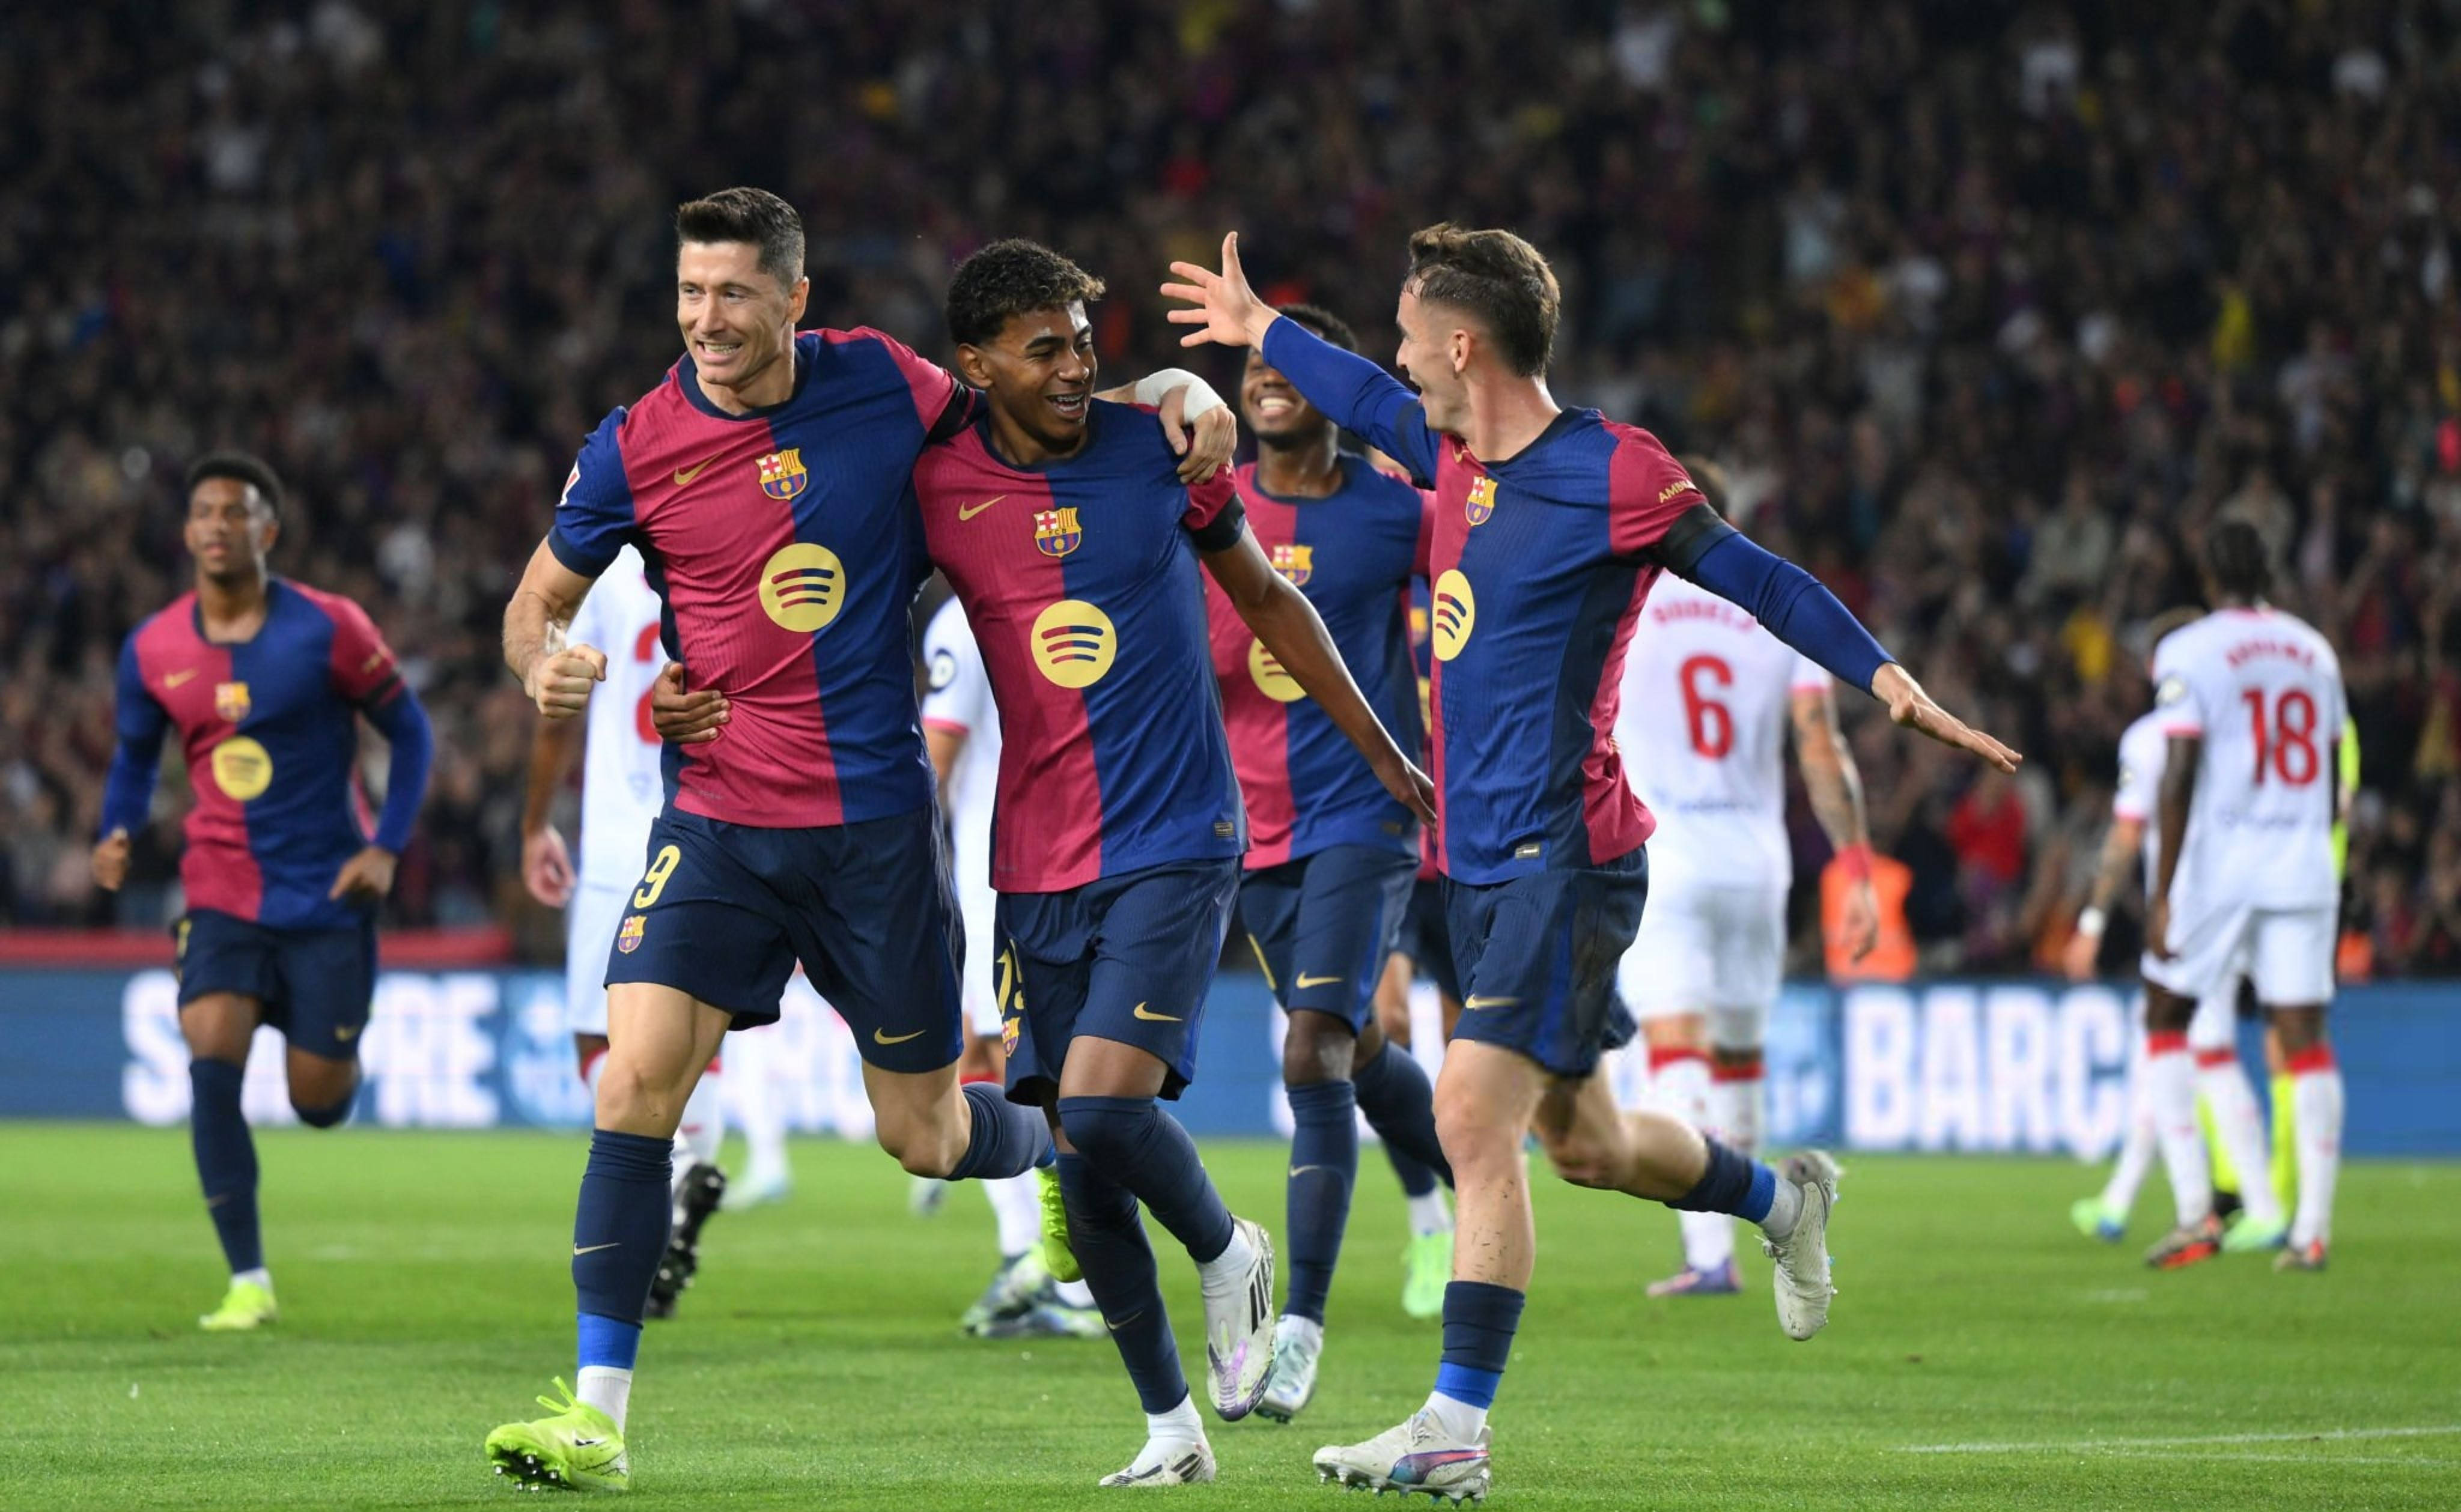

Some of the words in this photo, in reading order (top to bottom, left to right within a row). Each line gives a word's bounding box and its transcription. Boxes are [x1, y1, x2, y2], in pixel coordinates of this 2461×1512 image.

[1679, 652, 1734, 761] 6
[2240, 687, 2318, 789] 18
[633, 845, 681, 909] 9
